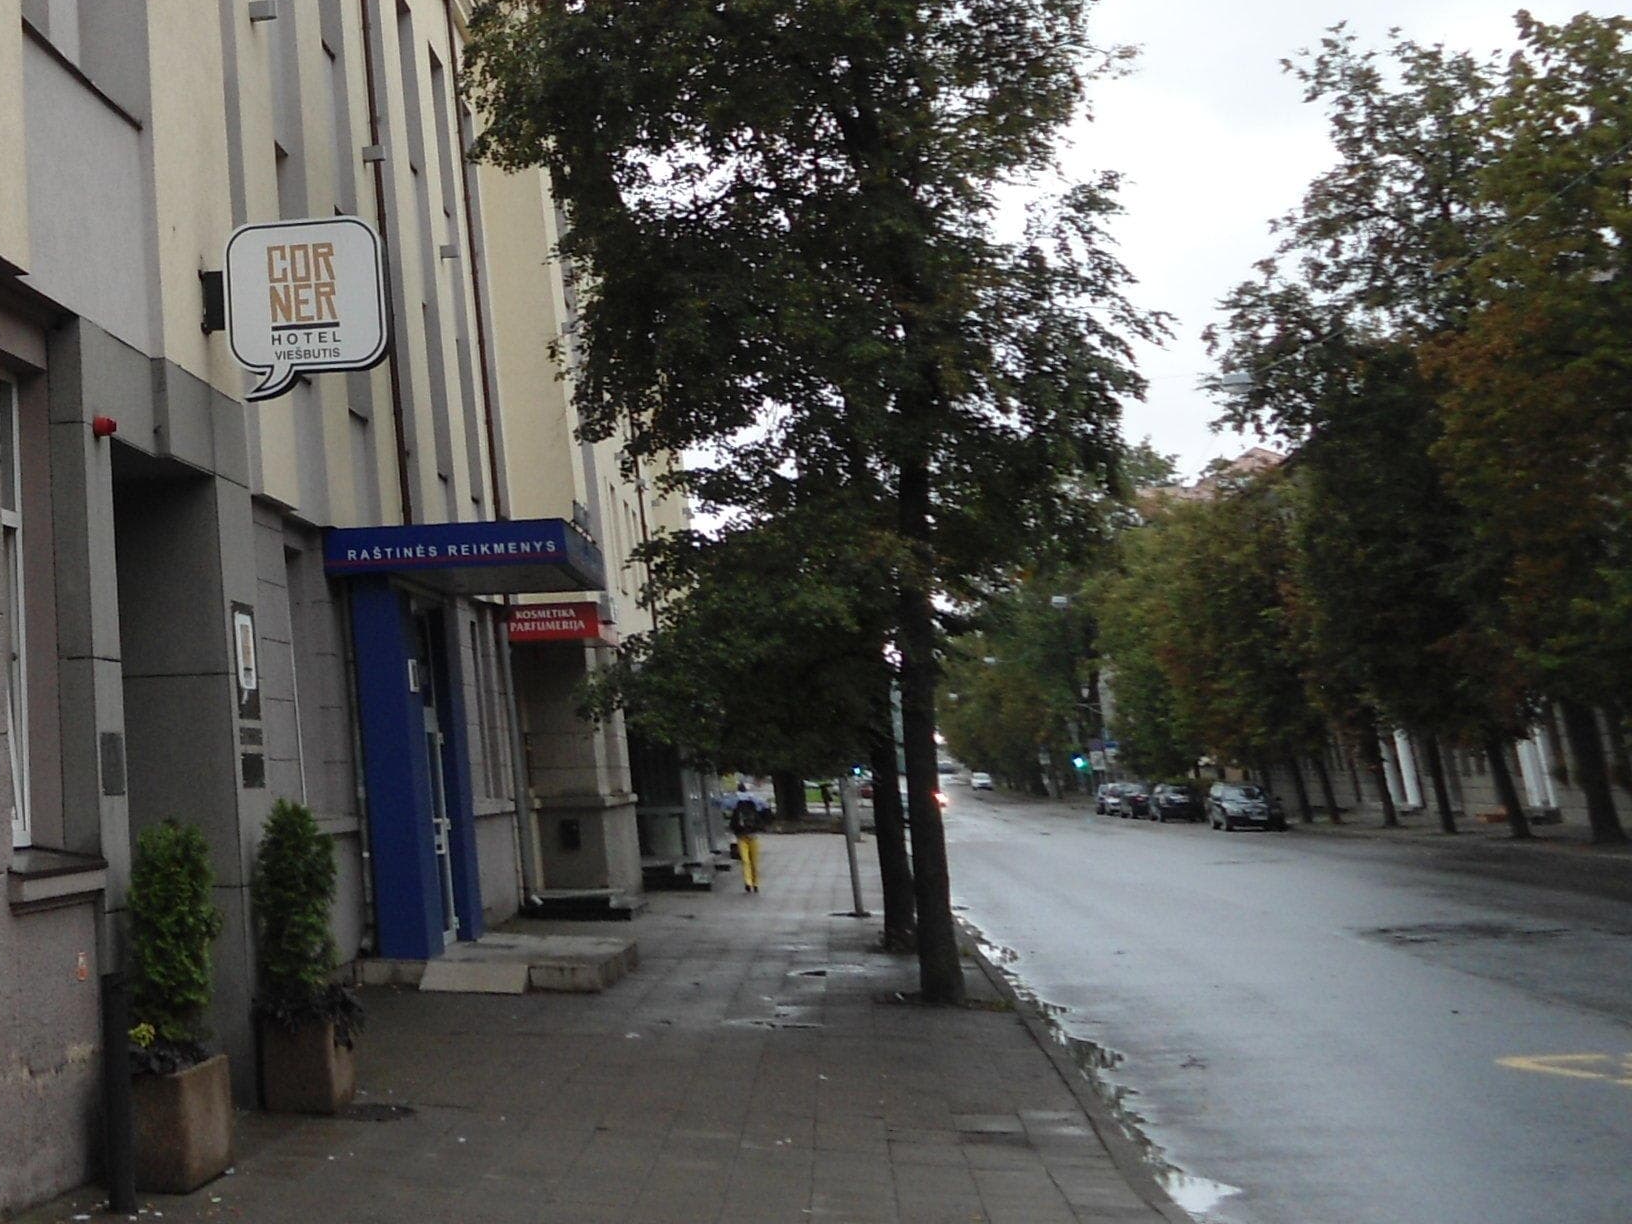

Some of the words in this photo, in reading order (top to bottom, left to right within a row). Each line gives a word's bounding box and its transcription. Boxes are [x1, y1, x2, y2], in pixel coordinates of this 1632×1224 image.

[267, 242, 335, 283] COR
[269, 282, 338, 322] NER
[271, 331, 342, 346] HOTEL
[274, 347, 340, 360] VIEŠBUTIS
[347, 545, 438, 561] RAŠTINĖS
[448, 540, 557, 556] REIKMENYS
[515, 608, 576, 620] KOSMETIKA
[510, 620, 585, 632] PARFUMERIJA
